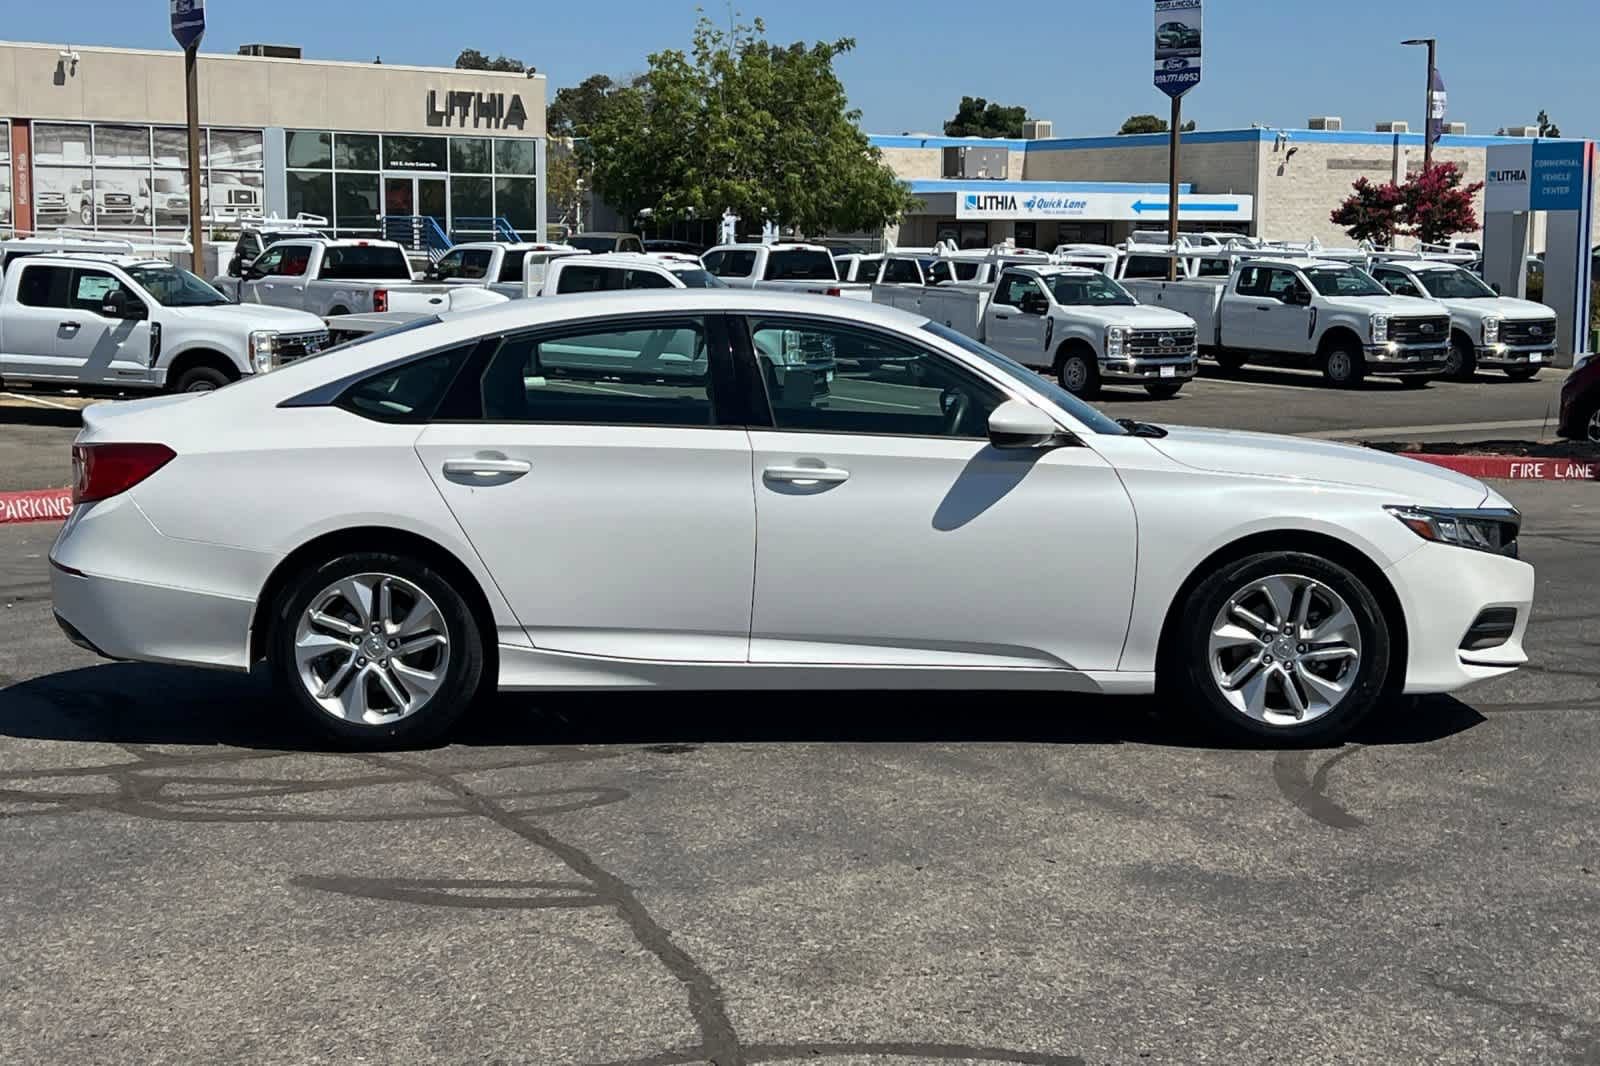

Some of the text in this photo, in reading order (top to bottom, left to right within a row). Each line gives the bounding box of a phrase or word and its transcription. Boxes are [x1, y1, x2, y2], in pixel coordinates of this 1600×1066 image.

[426, 90, 528, 130] LITHIA
[1534, 160, 1581, 168] COMMERCIAL
[1497, 170, 1527, 181] LITHIA
[1542, 173, 1572, 181] VEHICLE
[1542, 187, 1570, 195] CENTER
[977, 195, 1087, 211] LITHIA Quick Lane
[1510, 463, 1596, 479] FIRE LANE
